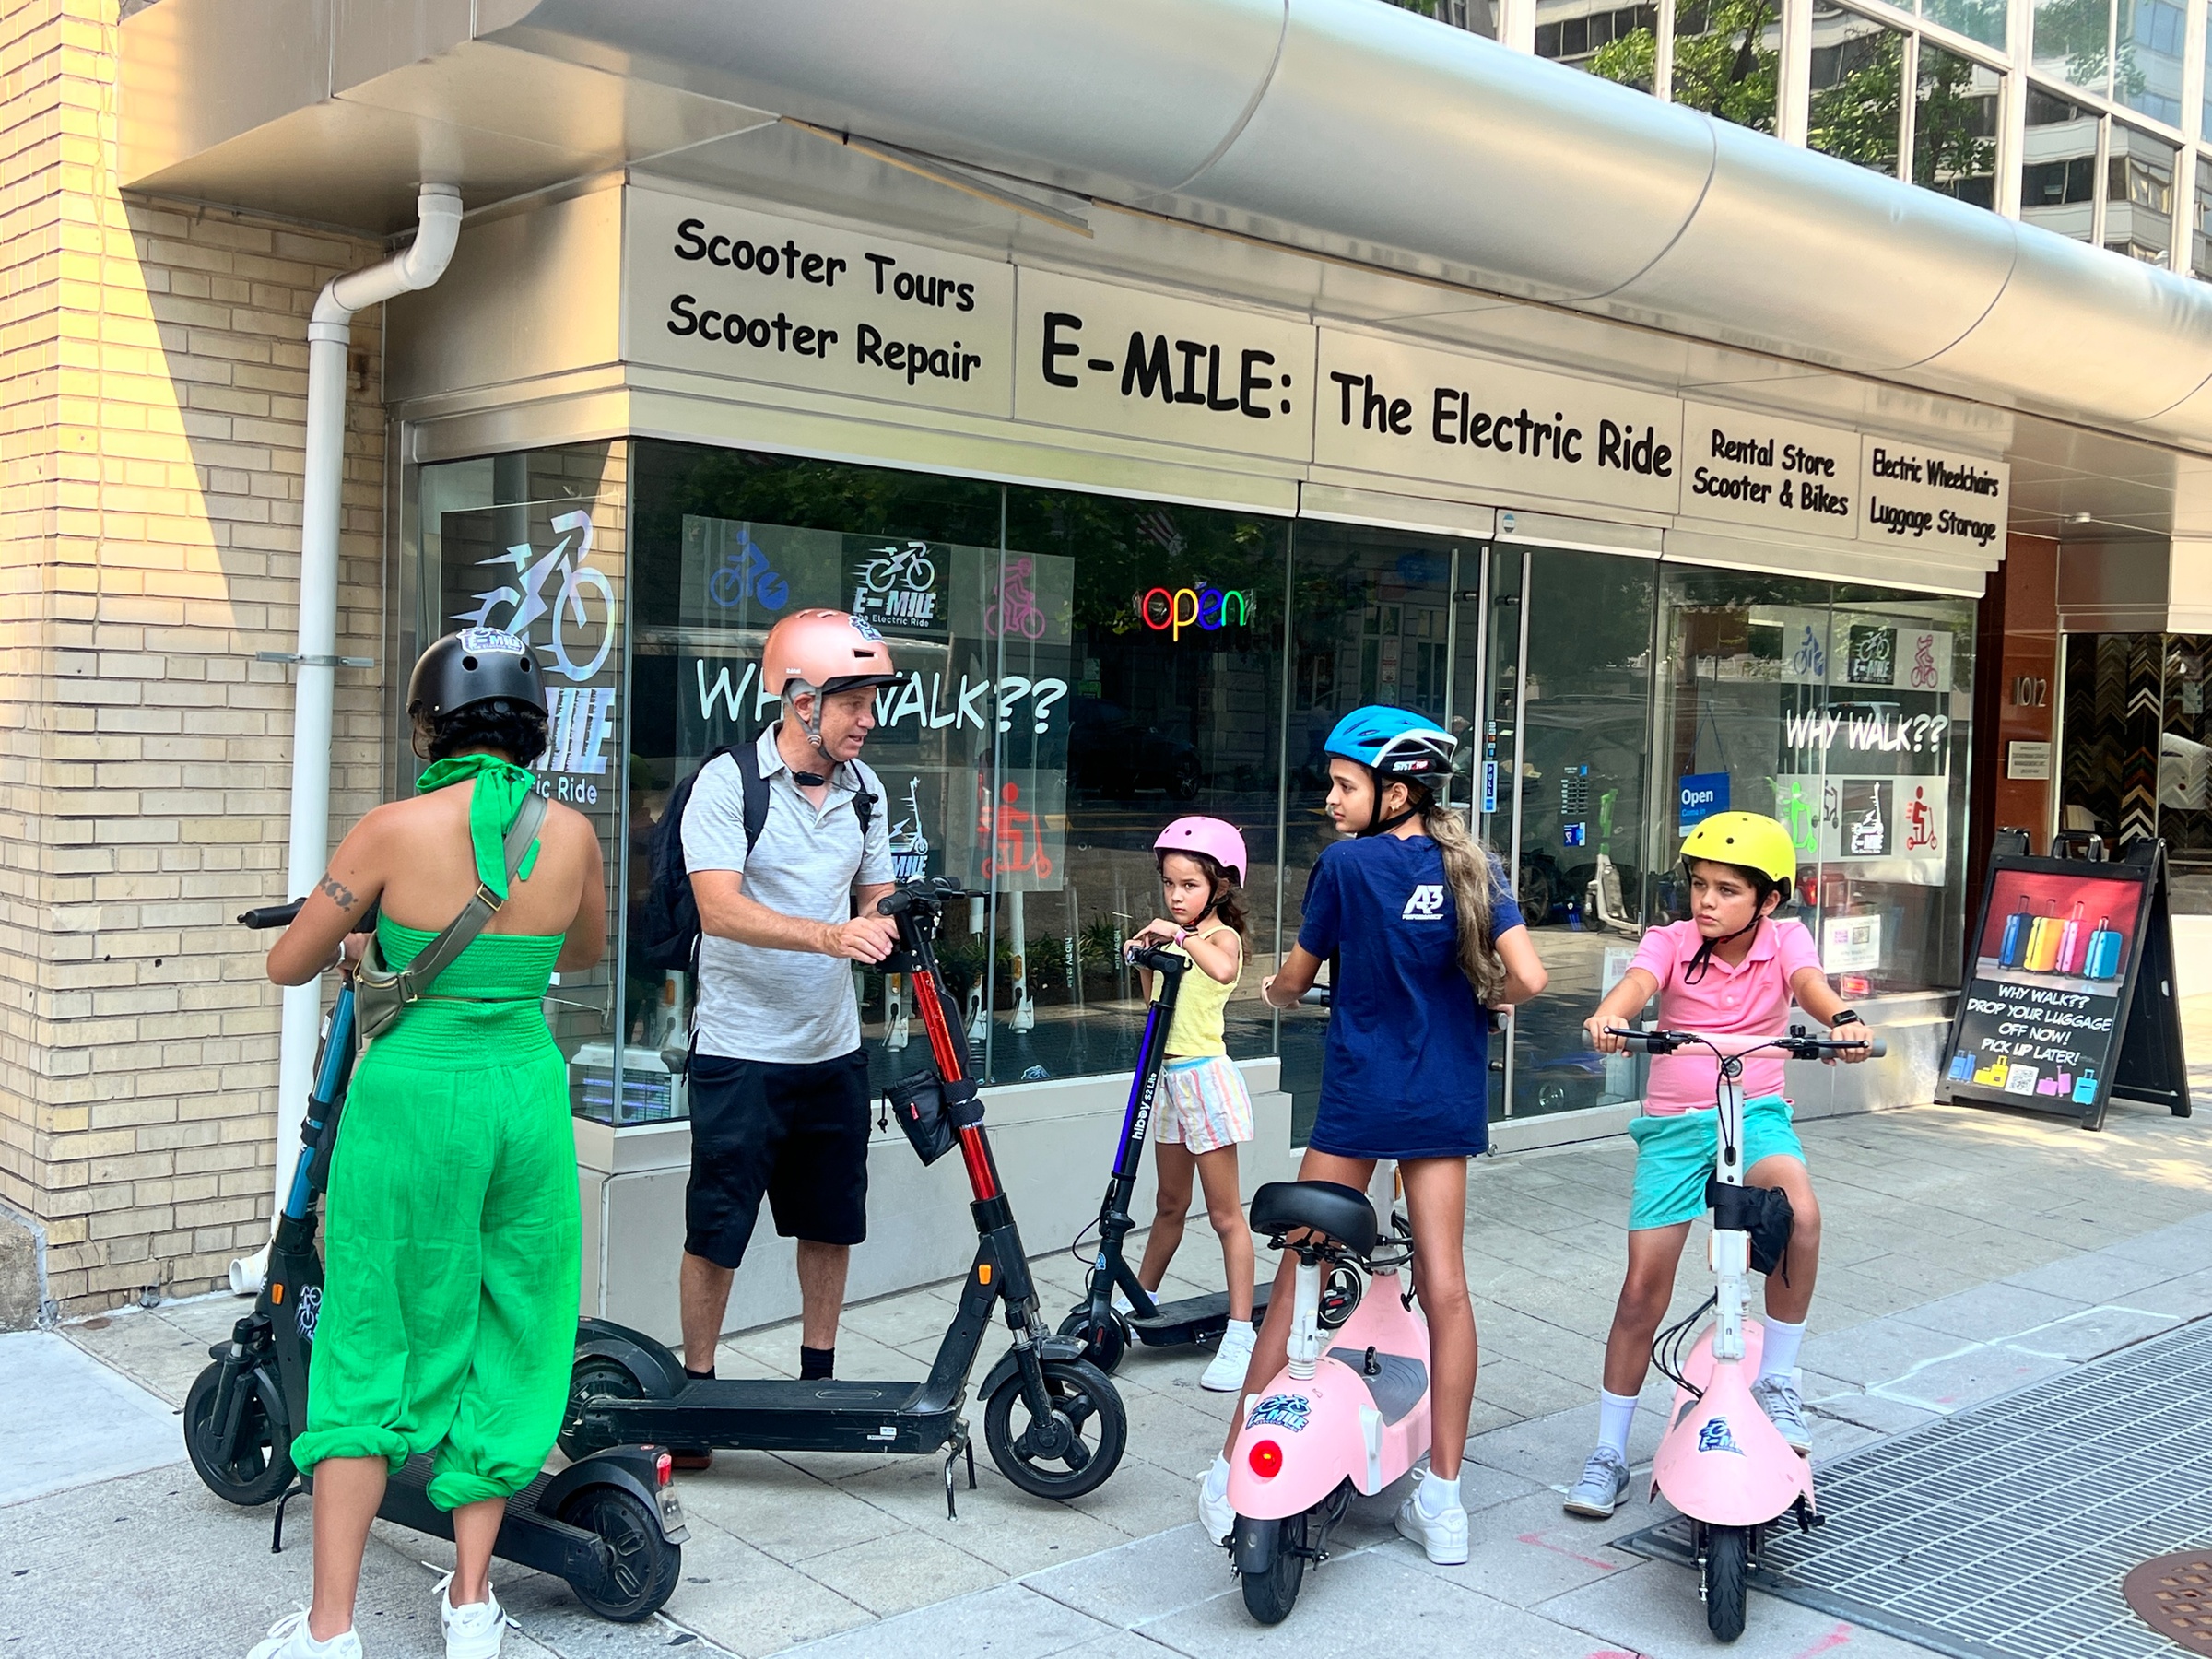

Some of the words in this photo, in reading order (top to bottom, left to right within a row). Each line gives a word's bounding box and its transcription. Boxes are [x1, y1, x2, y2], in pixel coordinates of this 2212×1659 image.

[675, 218, 846, 288] Scooter
[864, 252, 975, 312] Tours
[666, 294, 839, 359] Scooter
[856, 323, 982, 386] Repair
[1041, 312, 1292, 419] E-MILE:
[1330, 371, 1413, 436] The
[1432, 387, 1583, 464] Electric
[1598, 418, 1673, 478] Ride
[1712, 429, 1775, 468] Rental
[1782, 444, 1836, 478] Store
[1692, 467, 1772, 505] Scooter
[1779, 479, 1794, 509] &
[1801, 482, 1849, 516] Bikes
[1873, 448, 1923, 485] Electric
[1927, 459, 2000, 498] Wheelchairs
[1870, 495, 1934, 538] Luggage
[1936, 509, 1997, 547] Storage
[853, 586, 937, 619] E-MILE
[872, 614, 908, 627] Electric
[910, 618, 930, 628] Ride
[1142, 587, 1245, 642] open
[697, 658, 784, 723] WH
[2016, 677, 2047, 708] 1012
[1786, 709, 1842, 750] WHY
[1849, 712, 1949, 753] WALK??
[558, 775, 598, 805] Ride
[1681, 789, 1713, 807] Open
[1403, 884, 1444, 914] A3
[1966, 997, 2007, 1015] DROP
[2006, 1004, 2042, 1022] YOUR
[2044, 1009, 2113, 1033] LUGGAGE
[1998, 984, 2030, 1000] WHY
[2031, 990, 2091, 1009] WALK??
[1981, 1038, 2013, 1054] PICK
[2012, 1042, 2033, 1057] UP
[2033, 1046, 2081, 1066] LATER!
[1998, 1022, 2030, 1038] OFF
[2029, 1027, 2072, 1046] NOW!
[1145, 1088, 1153, 1100] S2
[1147, 1072, 1158, 1088] Lite
[1131, 1100, 1151, 1140] hiboy
